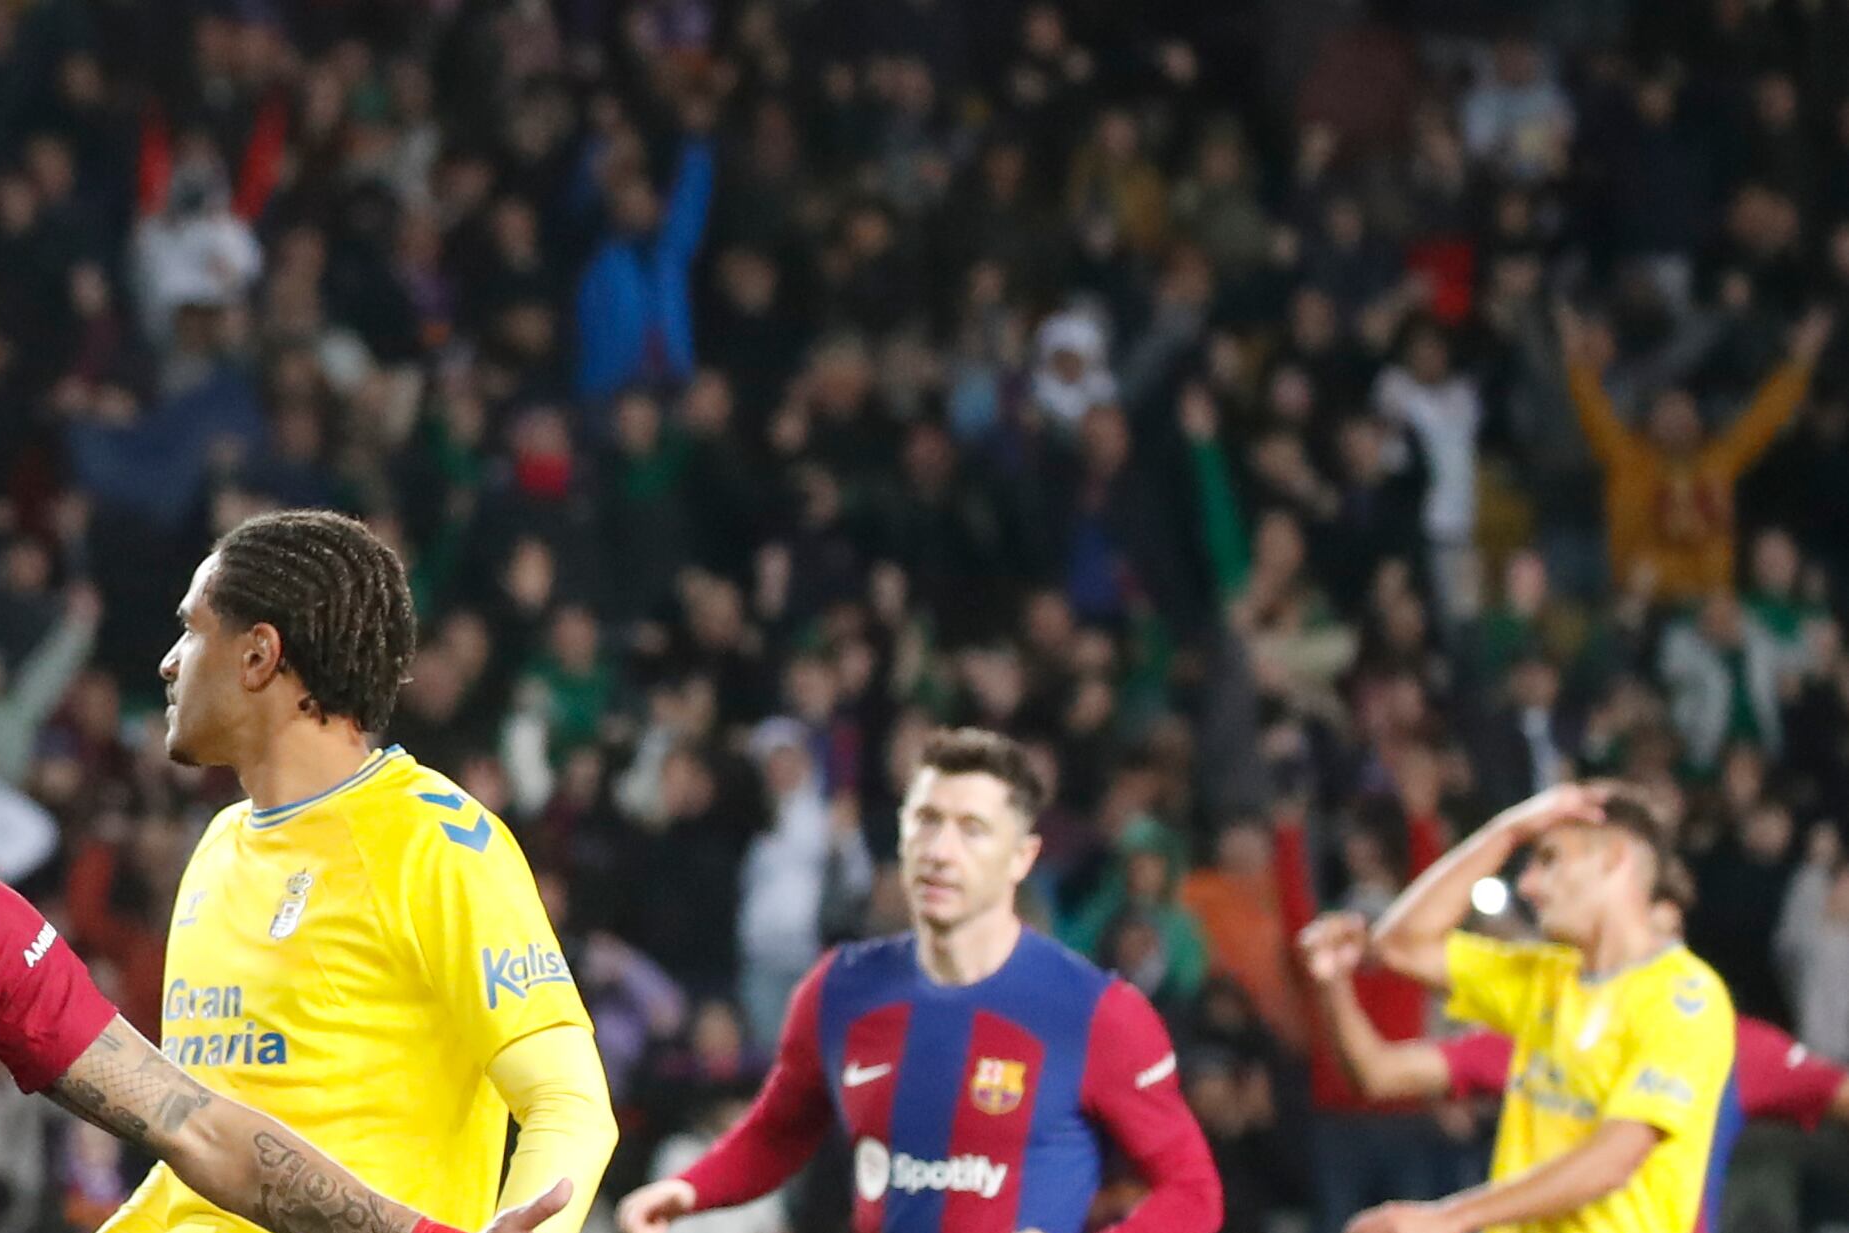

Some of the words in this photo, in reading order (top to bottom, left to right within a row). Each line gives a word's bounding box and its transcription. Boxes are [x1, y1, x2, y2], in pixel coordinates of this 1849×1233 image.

[165, 978, 242, 1020] Gran
[164, 1021, 287, 1066] anaria
[891, 1152, 1008, 1199] Spotify
